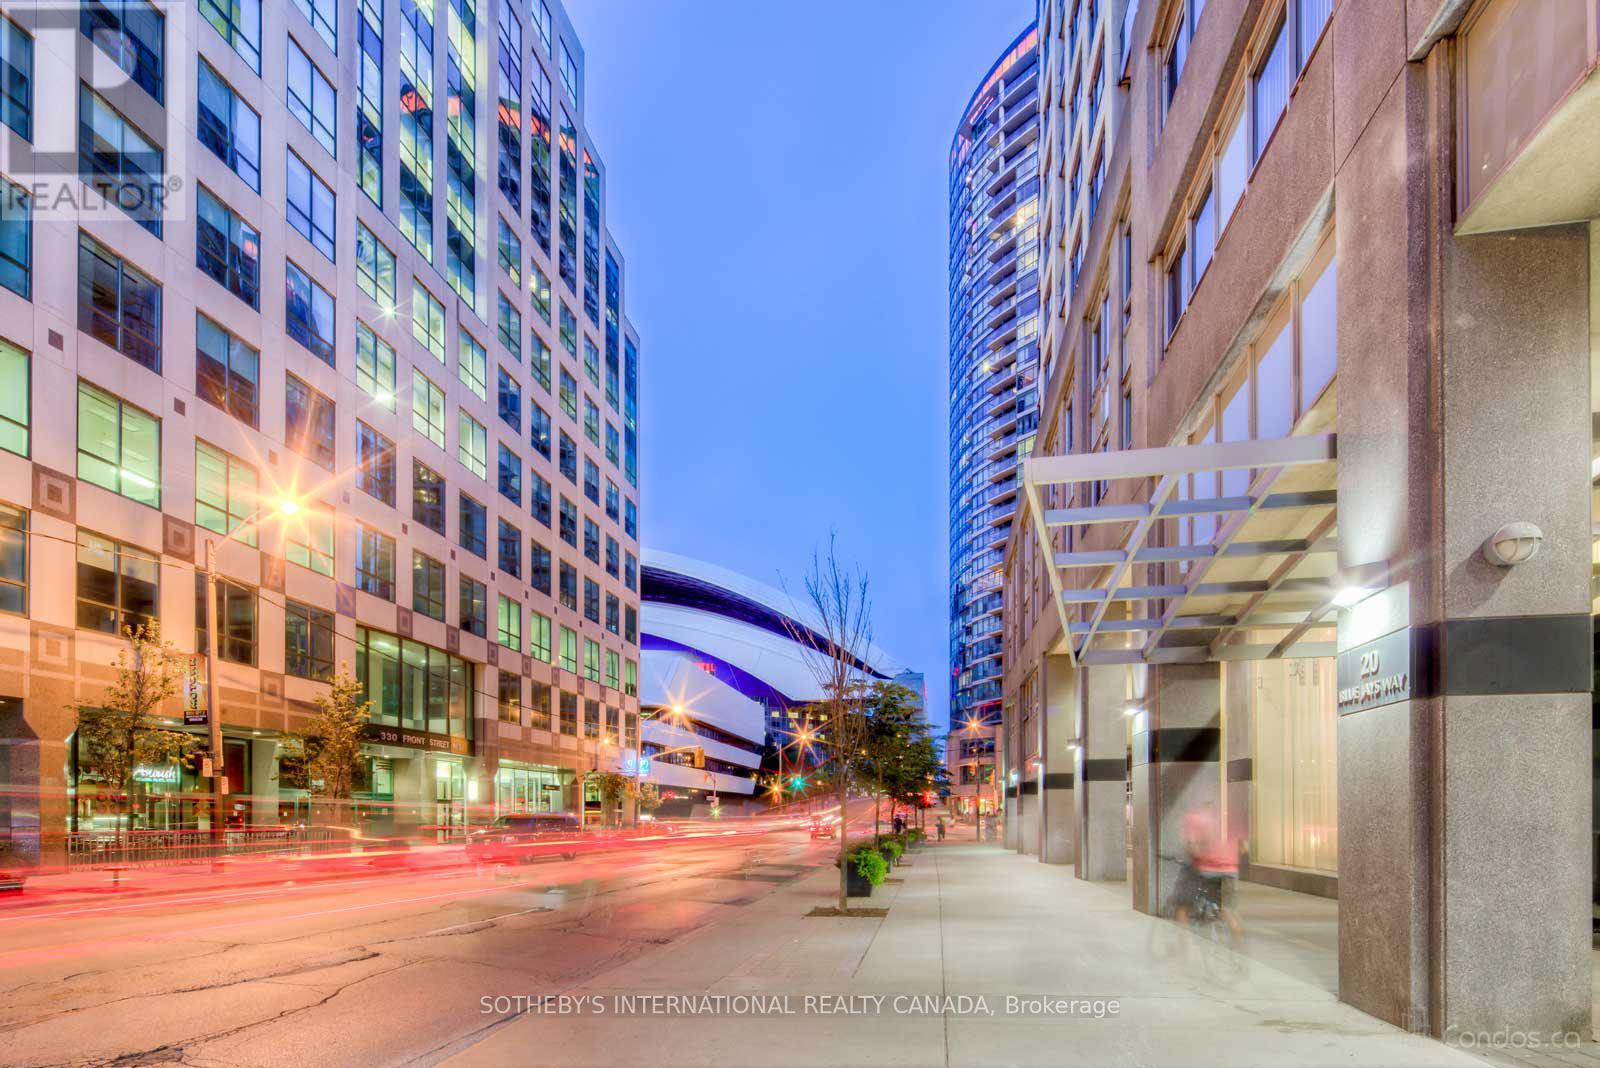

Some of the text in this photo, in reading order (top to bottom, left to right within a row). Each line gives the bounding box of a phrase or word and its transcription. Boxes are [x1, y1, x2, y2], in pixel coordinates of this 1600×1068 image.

[1360, 649, 1380, 679] 20
[381, 731, 398, 741] 330
[402, 734, 426, 746] FRONT
[429, 738, 450, 749] STREET
